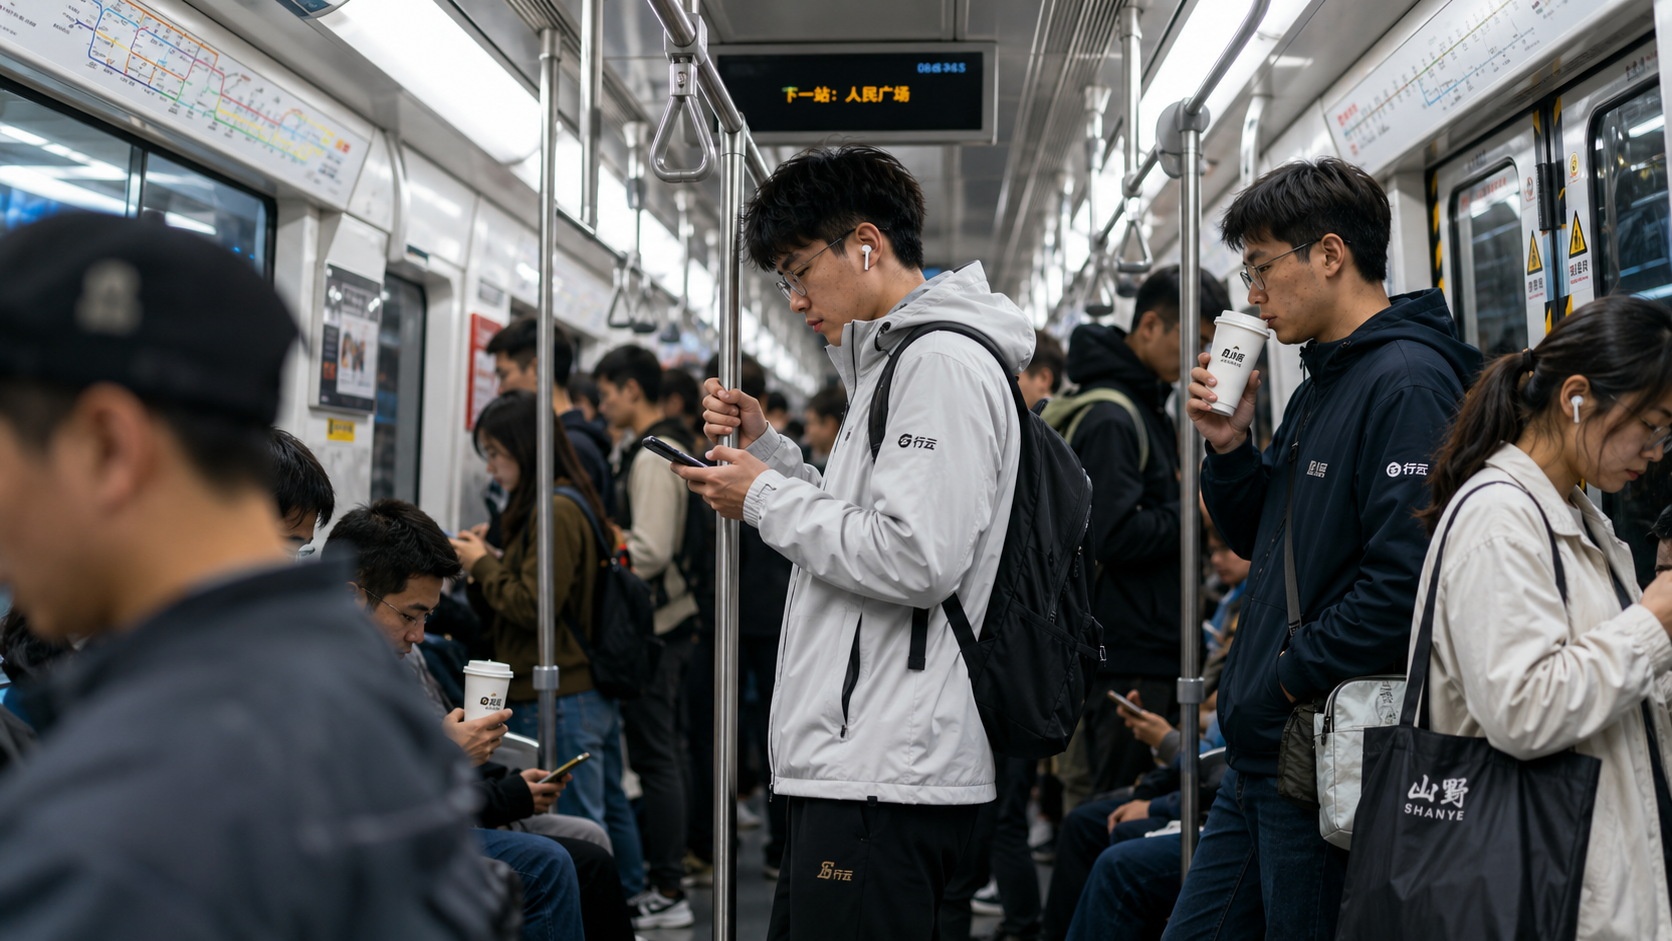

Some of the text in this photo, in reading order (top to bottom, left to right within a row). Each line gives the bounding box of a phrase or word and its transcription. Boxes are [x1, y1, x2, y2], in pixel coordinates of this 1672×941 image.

[913, 436, 937, 450] 行云
[1403, 462, 1429, 476] 行云
[1407, 774, 1469, 809] 山野
[1404, 802, 1465, 821] SHANYE
[833, 869, 854, 881] 行云
